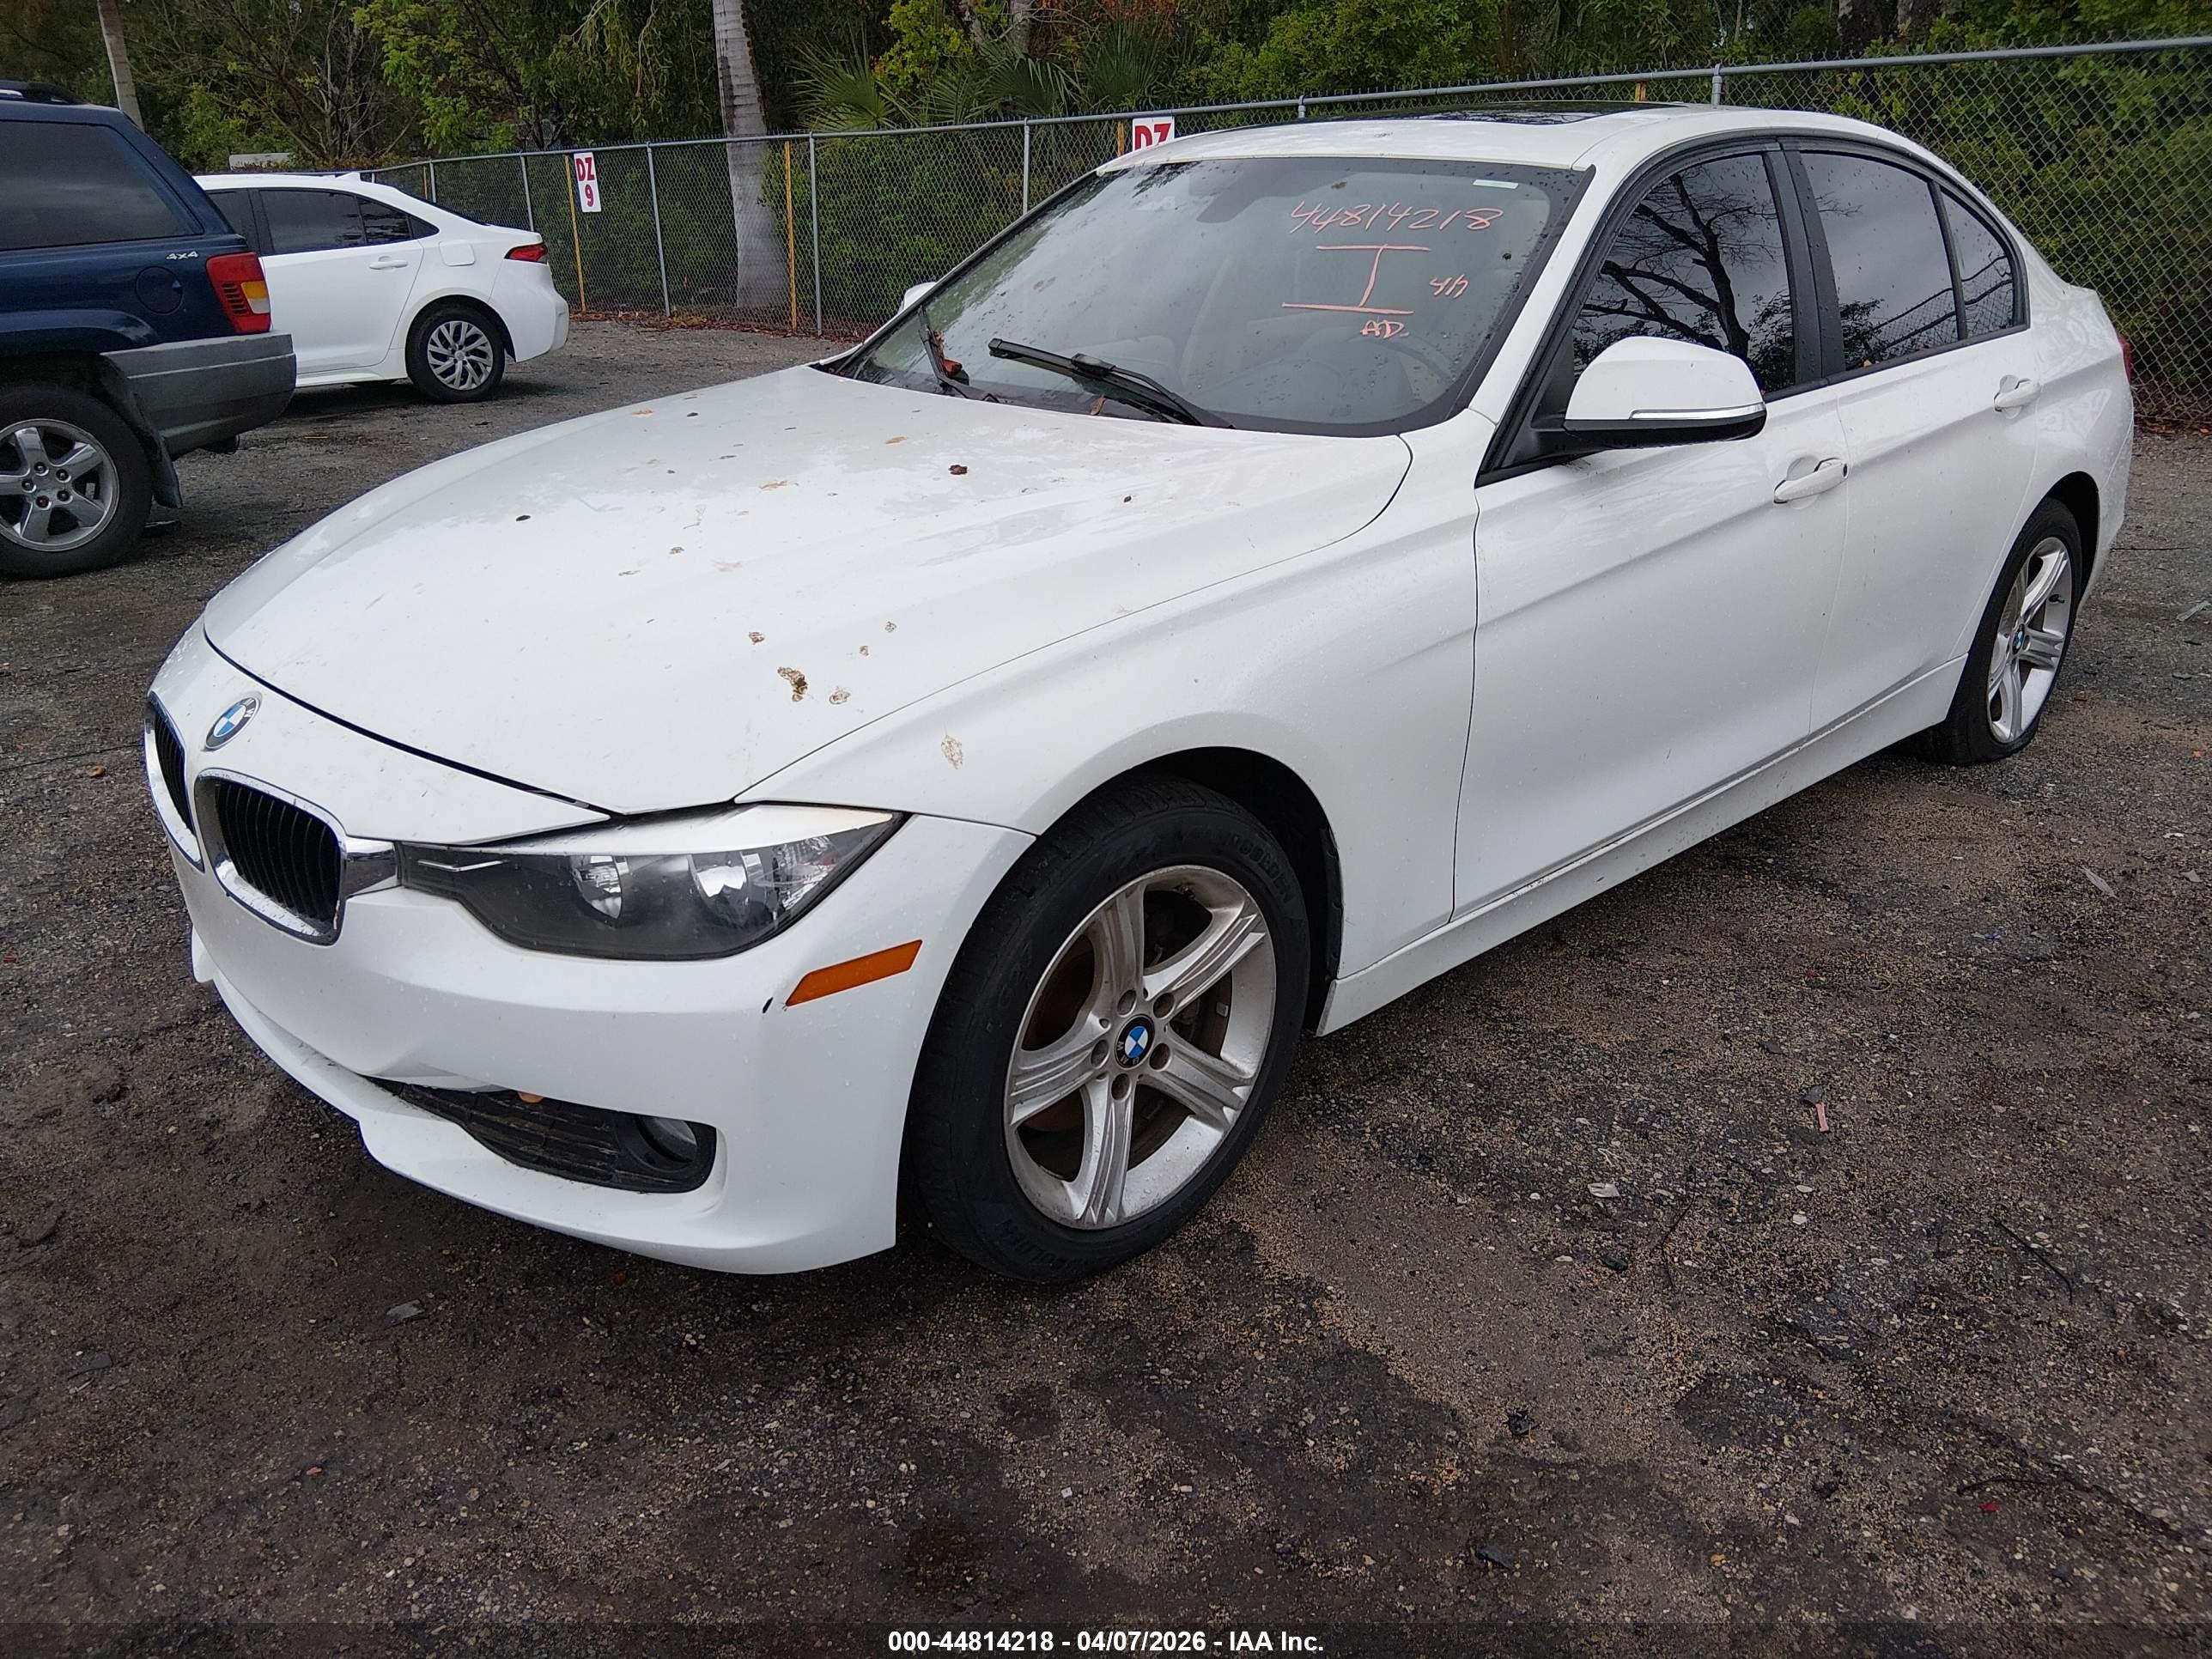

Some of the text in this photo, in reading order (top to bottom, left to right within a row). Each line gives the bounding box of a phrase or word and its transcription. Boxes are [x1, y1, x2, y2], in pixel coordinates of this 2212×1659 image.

[575, 156, 595, 181] DZ
[585, 184, 594, 207] 9
[1289, 201, 1504, 234] 44814218
